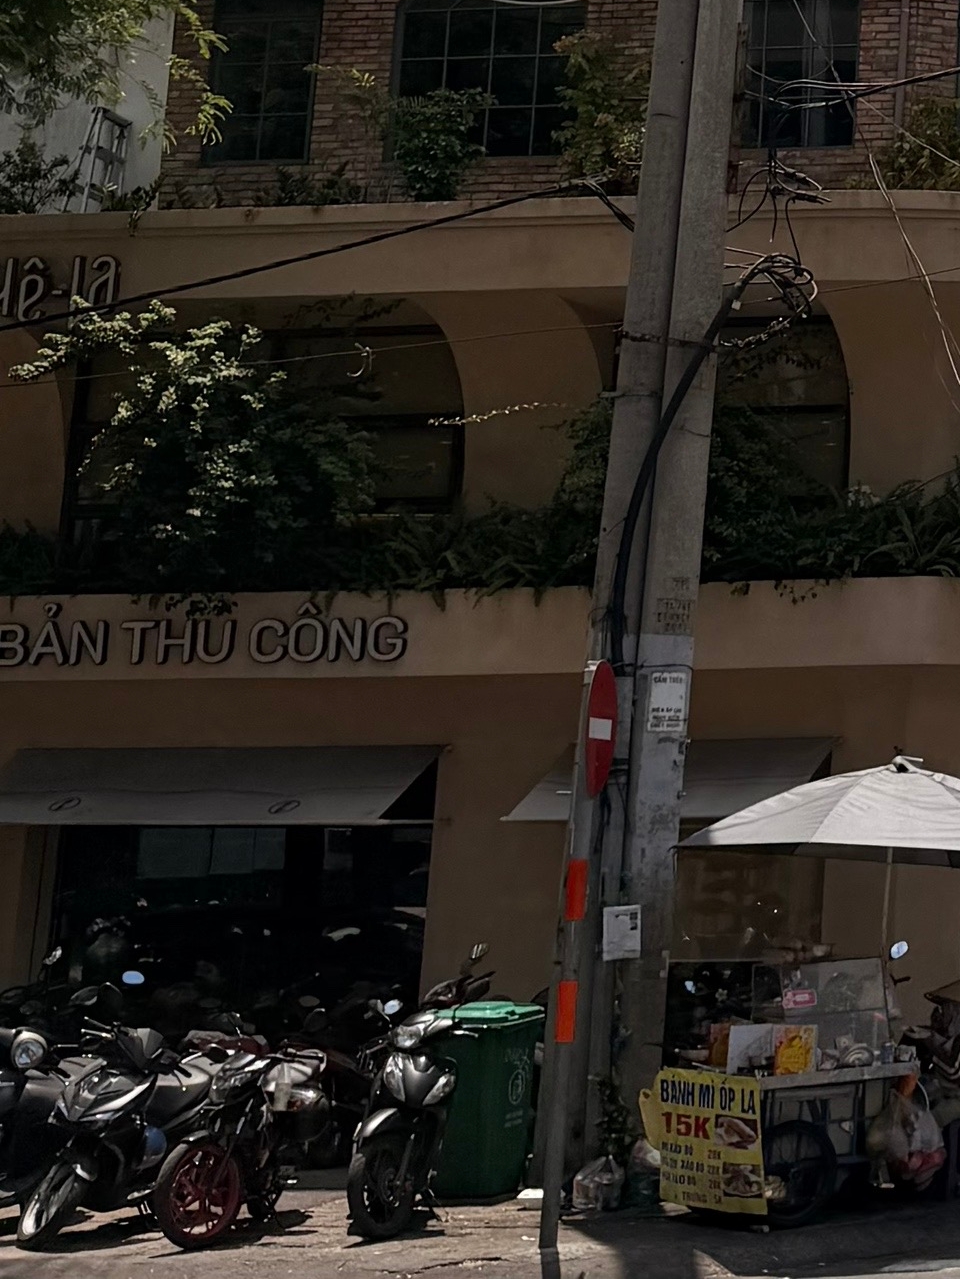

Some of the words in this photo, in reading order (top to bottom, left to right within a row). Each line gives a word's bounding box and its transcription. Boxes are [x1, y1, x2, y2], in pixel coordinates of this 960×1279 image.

[0, 602, 106, 667] BẢN
[248, 602, 407, 664] CÔNG
[661, 1074, 695, 1107] BÁNH
[699, 1078, 714, 1110] MÌ
[720, 1077, 735, 1112] ỐP
[741, 1088, 756, 1115] LA
[661, 1111, 710, 1140] 15K
